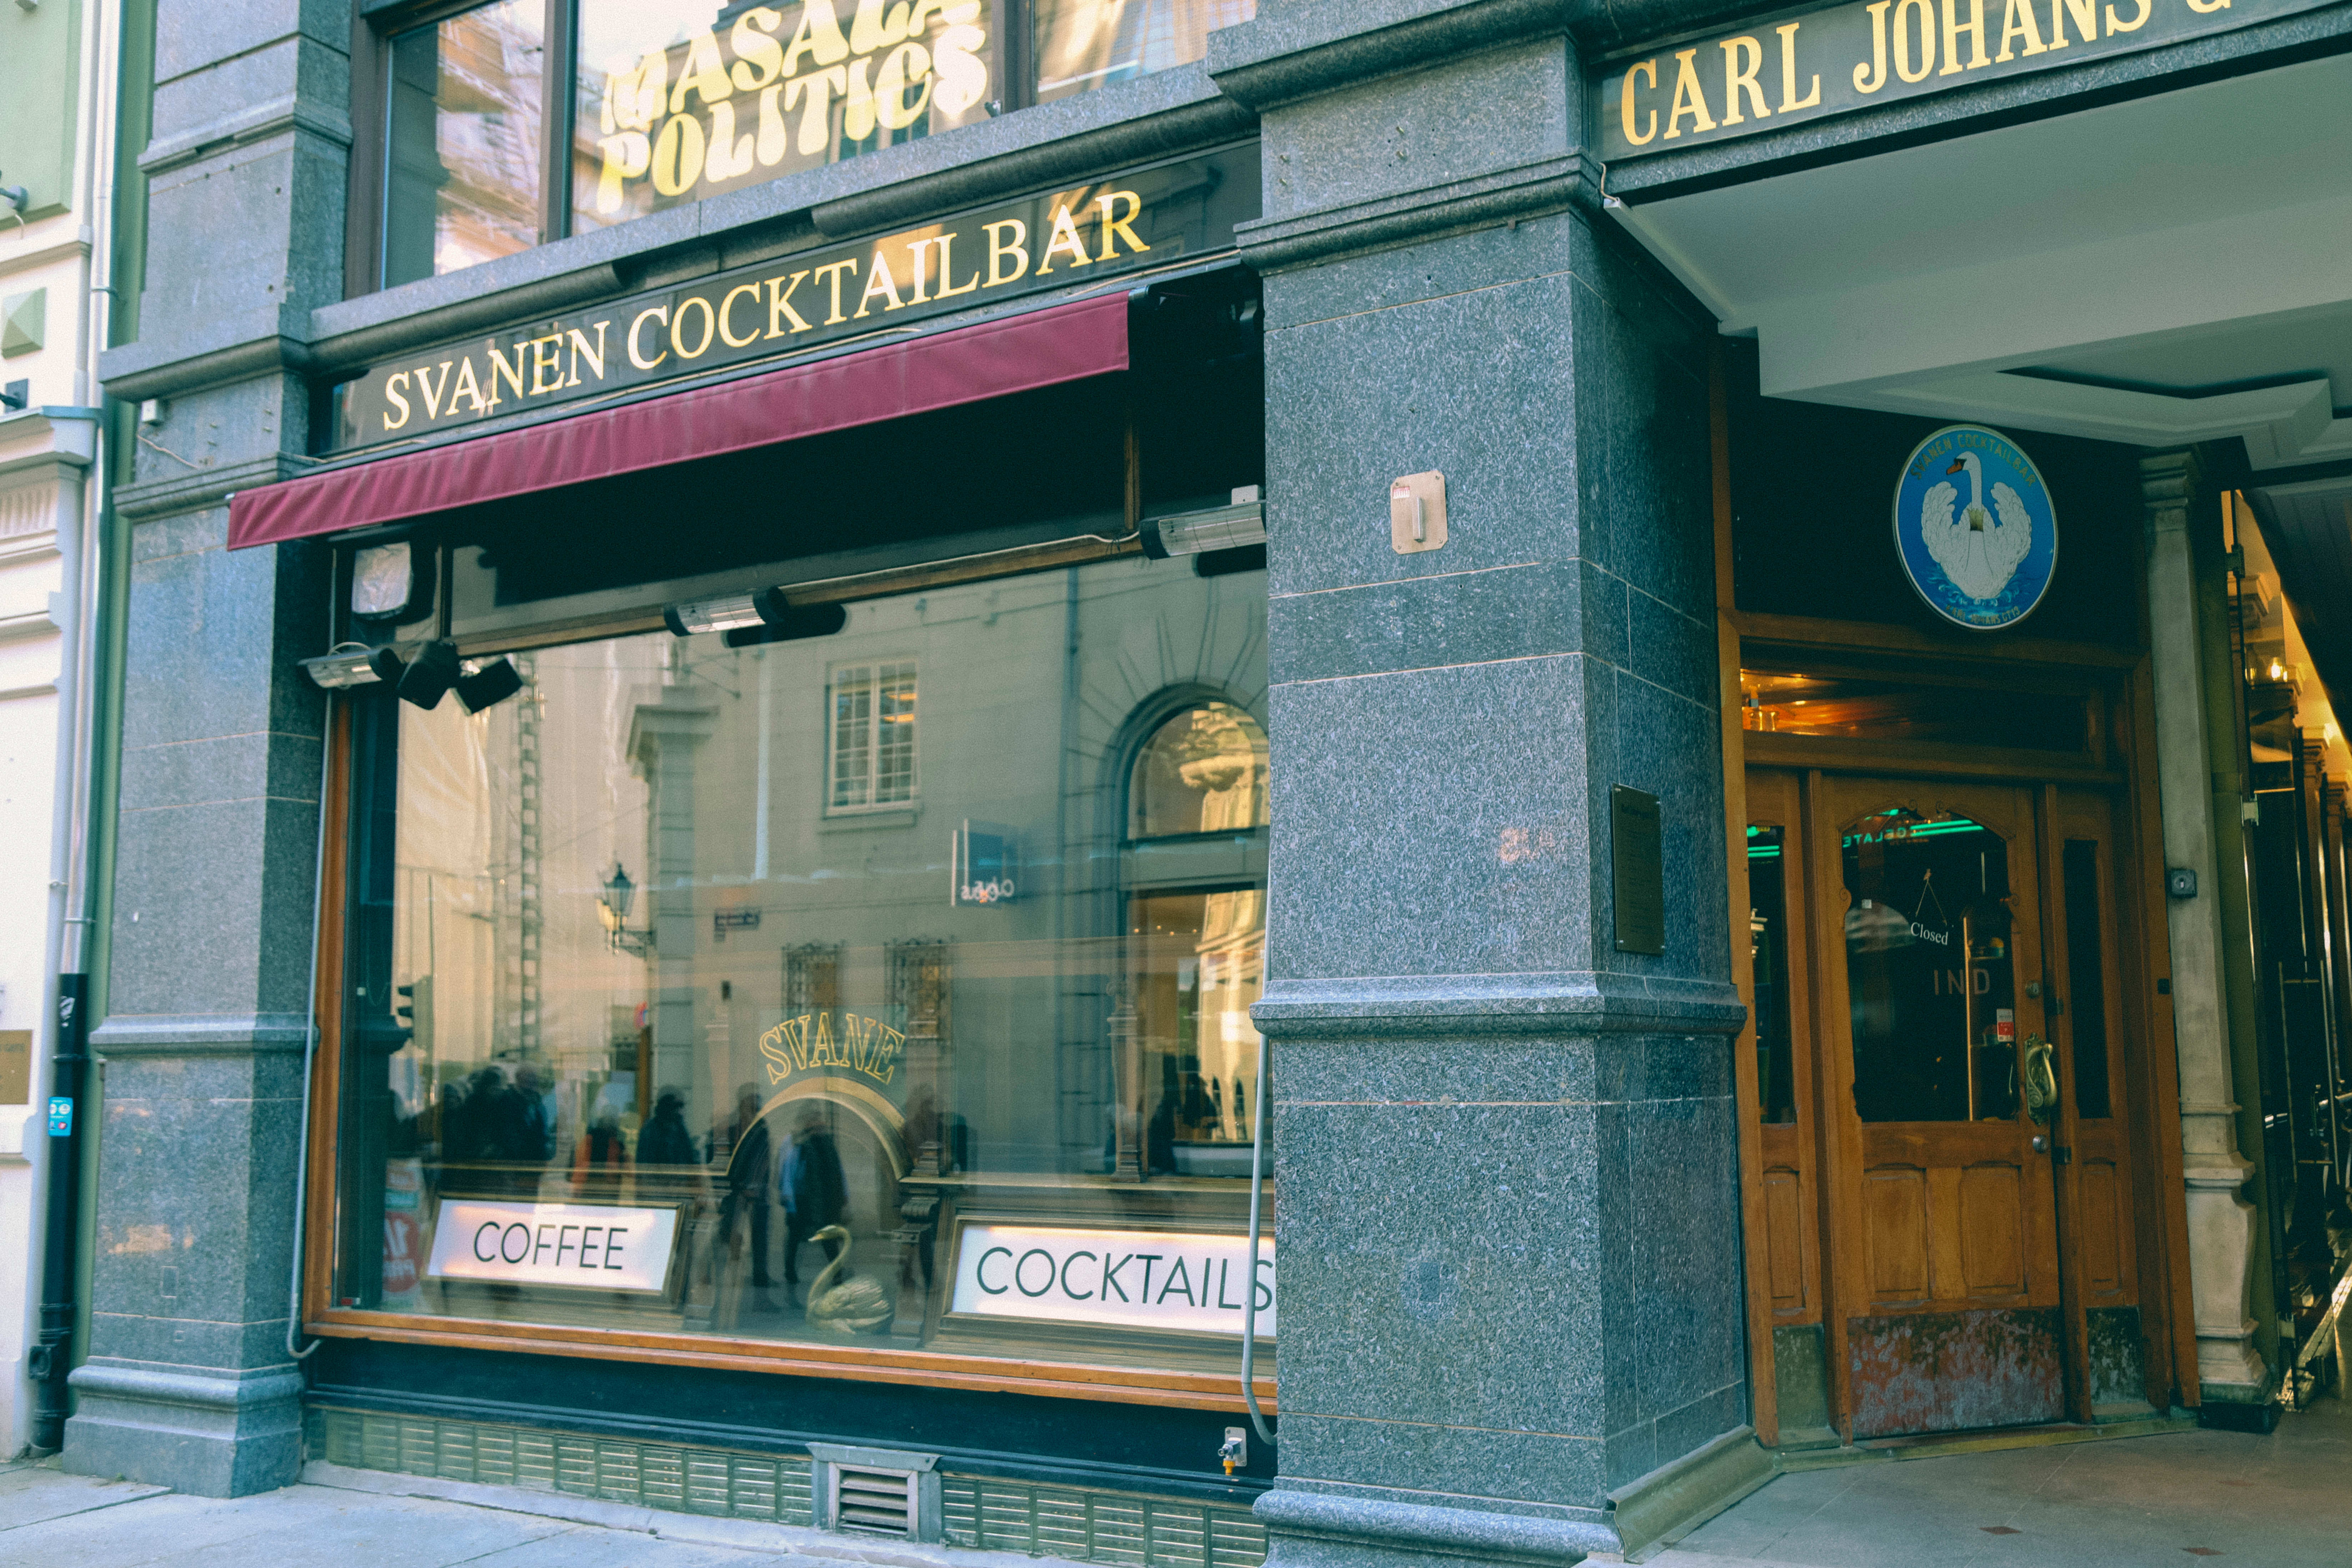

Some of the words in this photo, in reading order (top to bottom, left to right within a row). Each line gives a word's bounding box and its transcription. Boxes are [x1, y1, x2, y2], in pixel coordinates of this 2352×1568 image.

[1621, 23, 1820, 145] CARL
[597, 24, 987, 214] POLITICS
[383, 320, 610, 430] SVANEN
[628, 190, 1150, 370] COCKTAILBAR
[1911, 437, 1952, 480] SVANEN
[1957, 434, 2036, 487] COCKTAILBAR
[1911, 922, 1948, 946] Closed
[1934, 968, 1990, 996] IND
[759, 1012, 905, 1085] SVANE
[474, 1221, 628, 1270] COFFEE
[977, 1247, 1273, 1312] COCKTAILS
